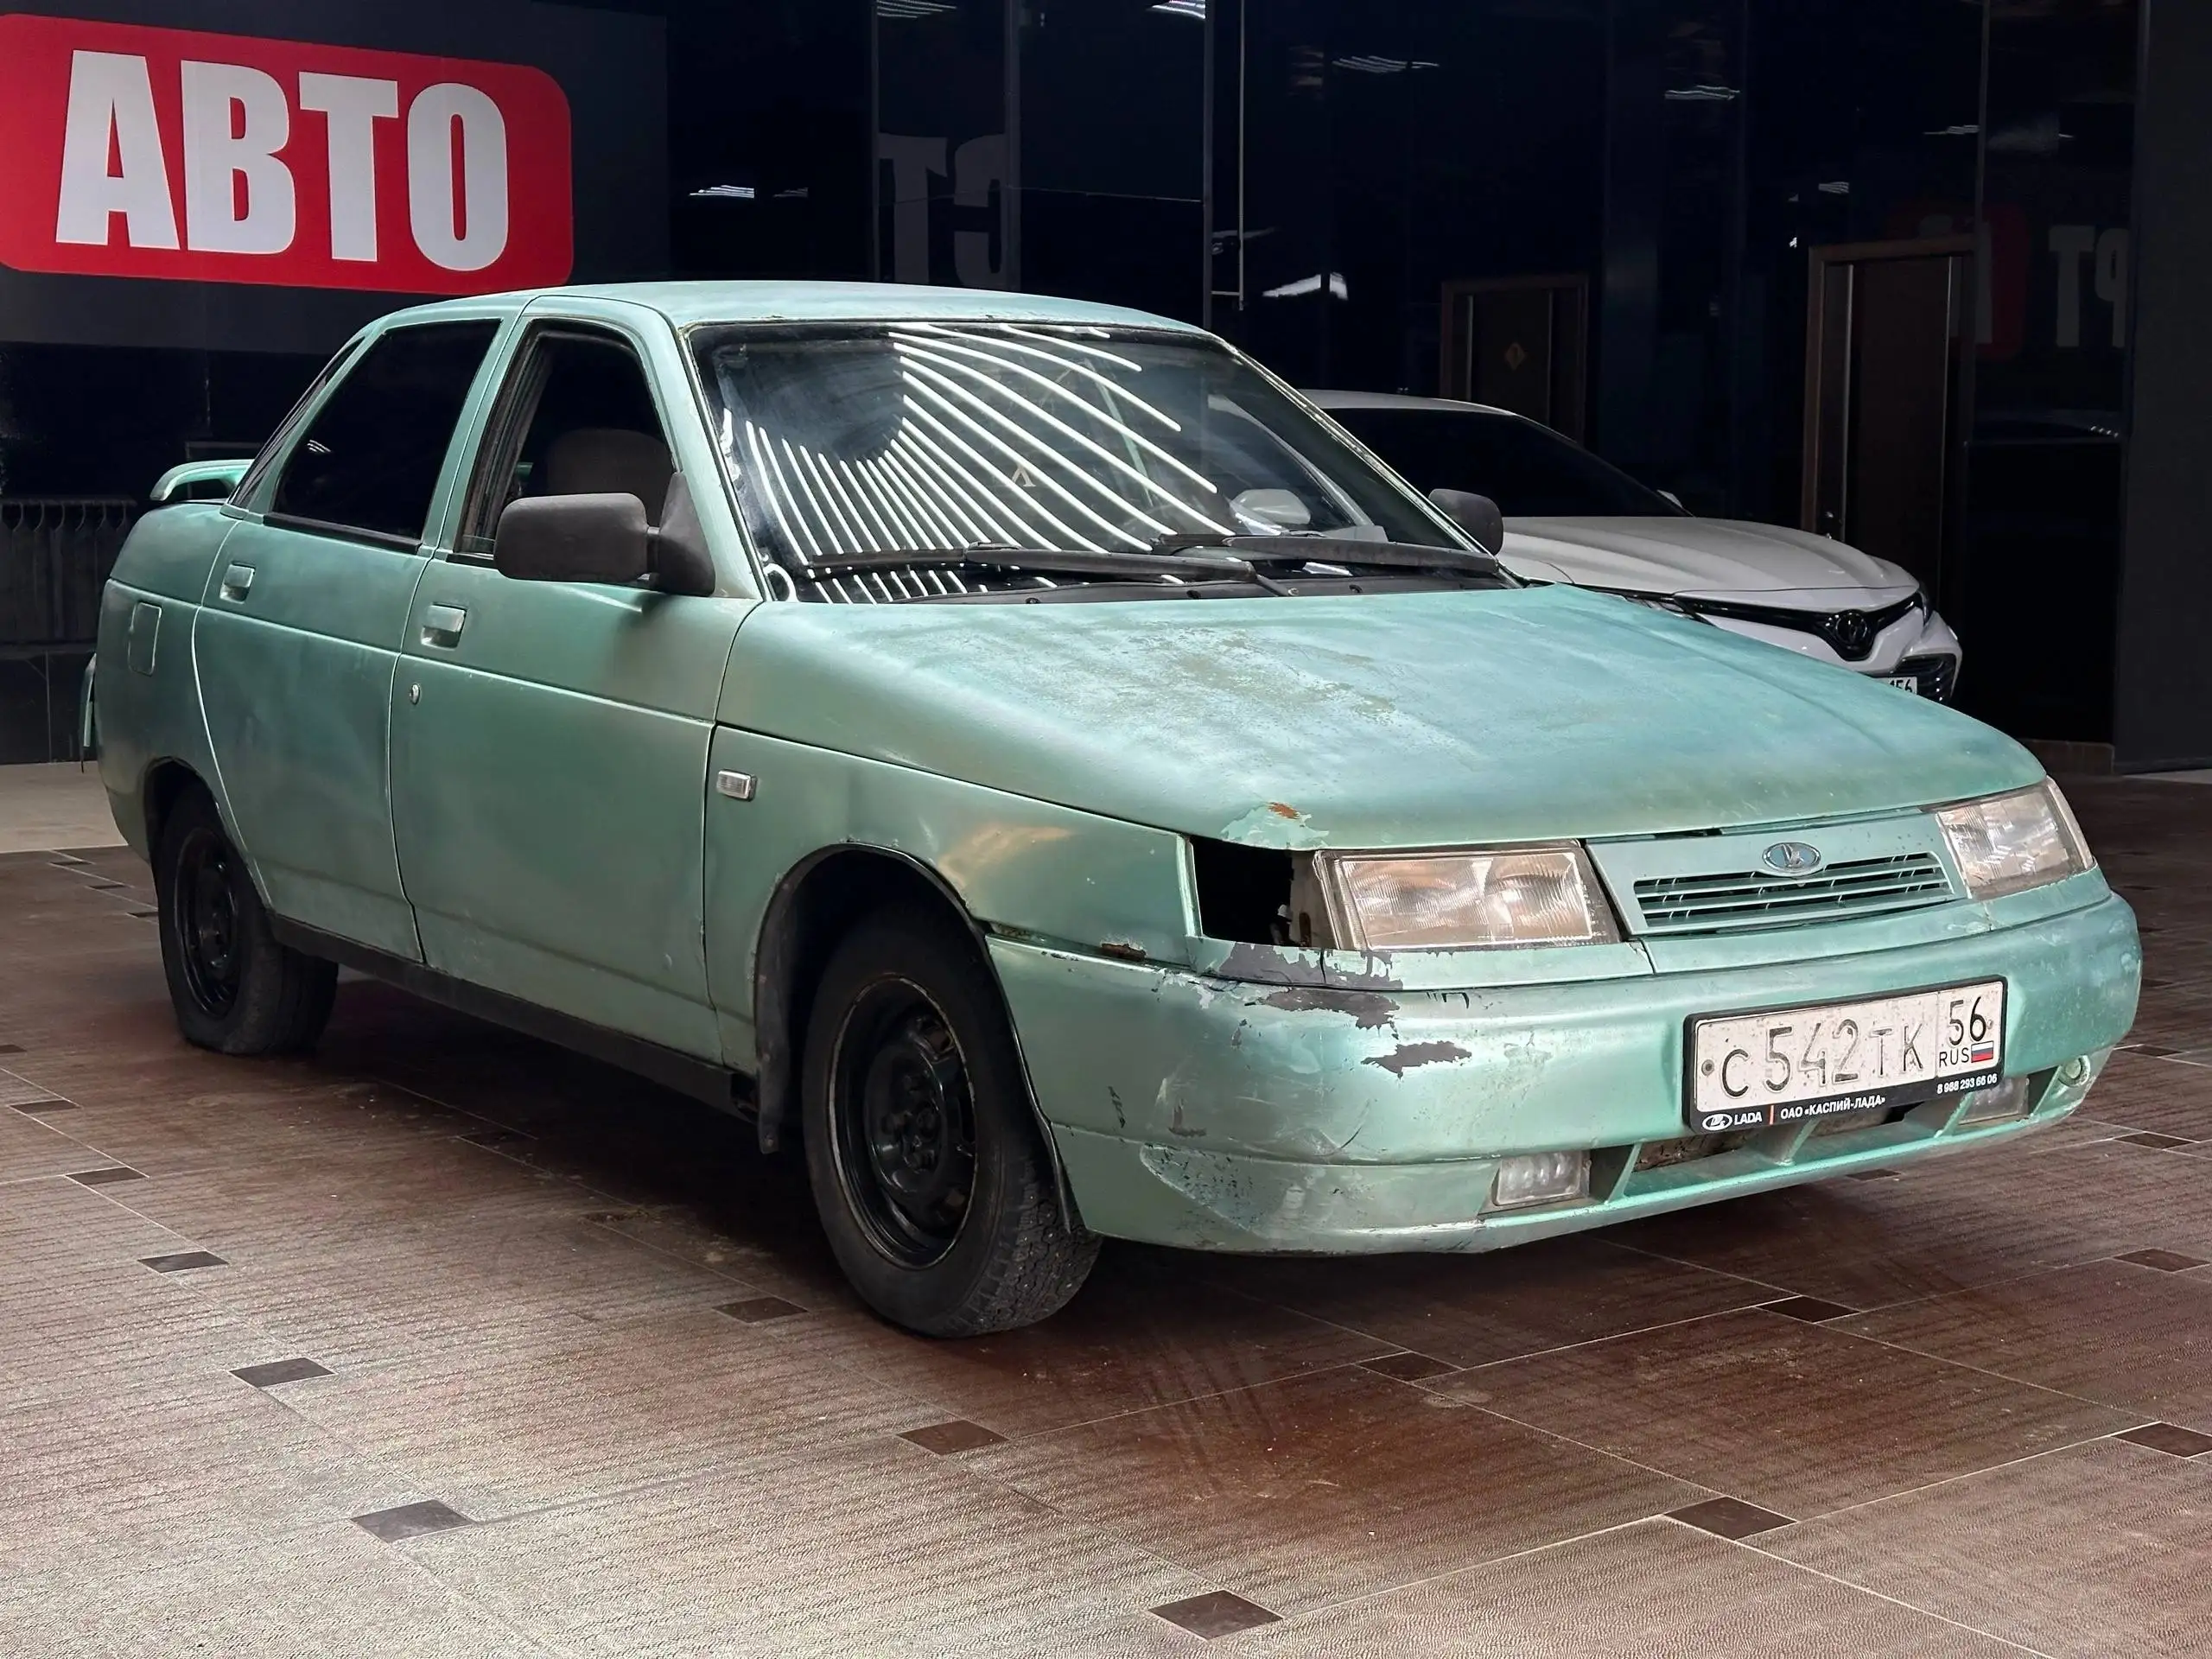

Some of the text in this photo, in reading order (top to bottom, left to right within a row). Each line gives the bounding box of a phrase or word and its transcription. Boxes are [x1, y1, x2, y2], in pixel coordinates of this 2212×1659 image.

[56, 49, 509, 271] АВТО
[1721, 995, 1986, 1097] С542ТК 56
[1938, 1047, 1969, 1069] RUS
[1937, 1084, 1943, 1094] 8
[1960, 1077, 1975, 1090] 293
[1987, 1073, 1998, 1084] 06
[1734, 1111, 1763, 1126] LADA
[1780, 1094, 1886, 1120] ОАО «КАСПИЙ-ЛАДА»
